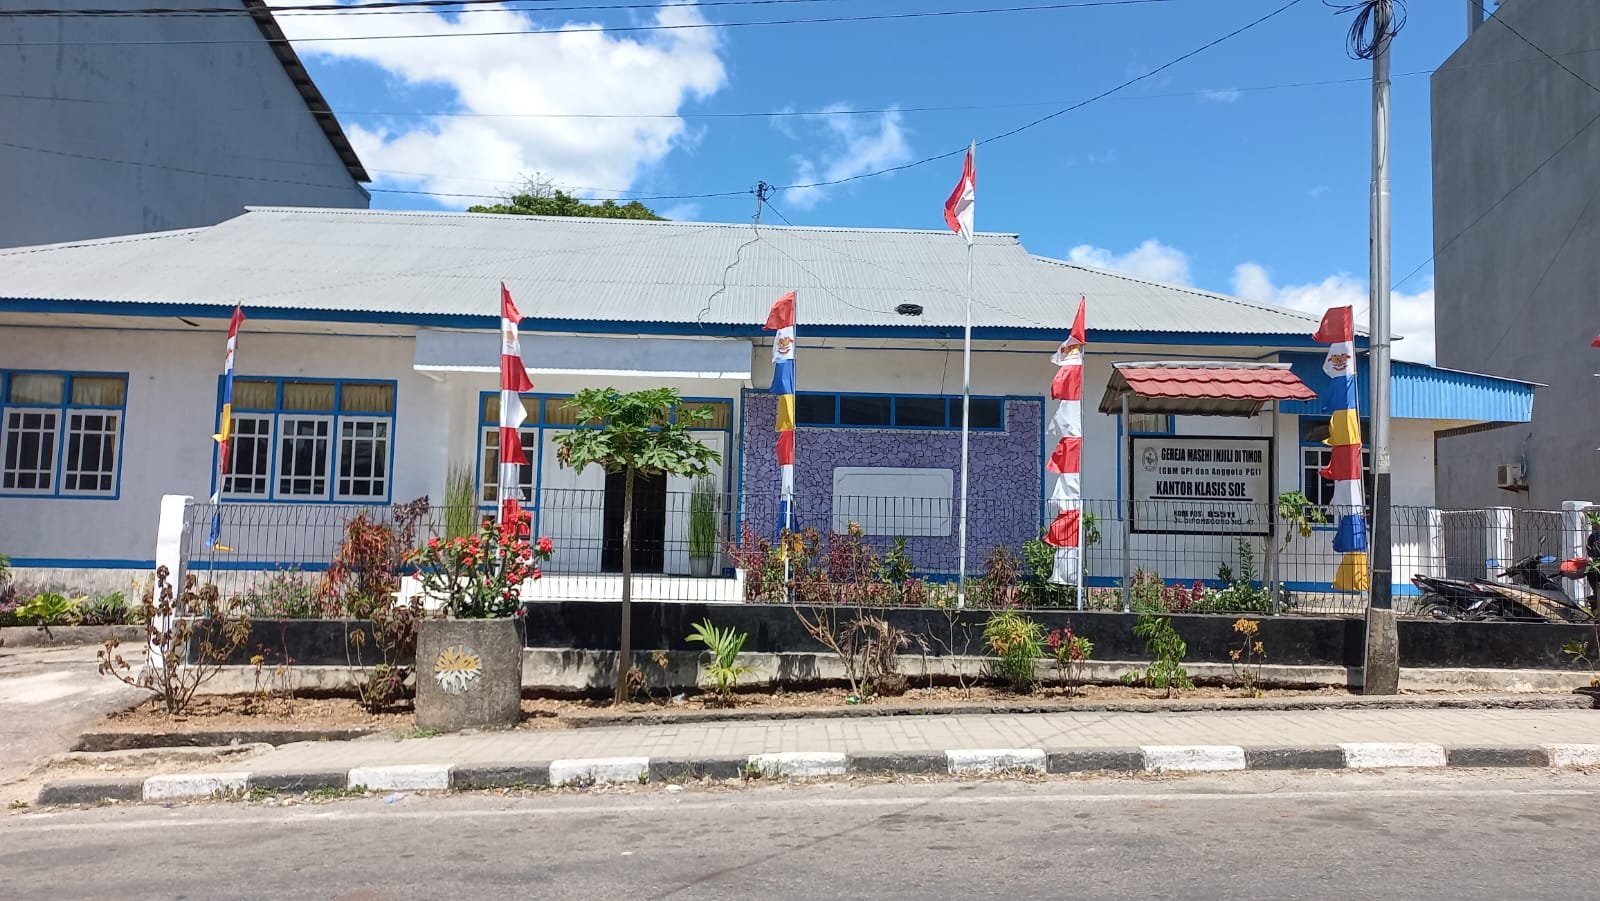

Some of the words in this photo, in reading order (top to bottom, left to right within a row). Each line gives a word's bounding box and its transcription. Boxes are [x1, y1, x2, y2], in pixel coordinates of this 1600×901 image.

[1161, 447, 1186, 461] GEREJA
[1187, 448, 1212, 462] MASEHI
[1234, 449, 1242, 462] DI
[1242, 450, 1262, 463] TIMOR
[1195, 467, 1210, 475] dan
[1156, 481, 1193, 495] KANTOR
[1194, 481, 1227, 496] KLASIS
[1228, 482, 1246, 497] SOE
